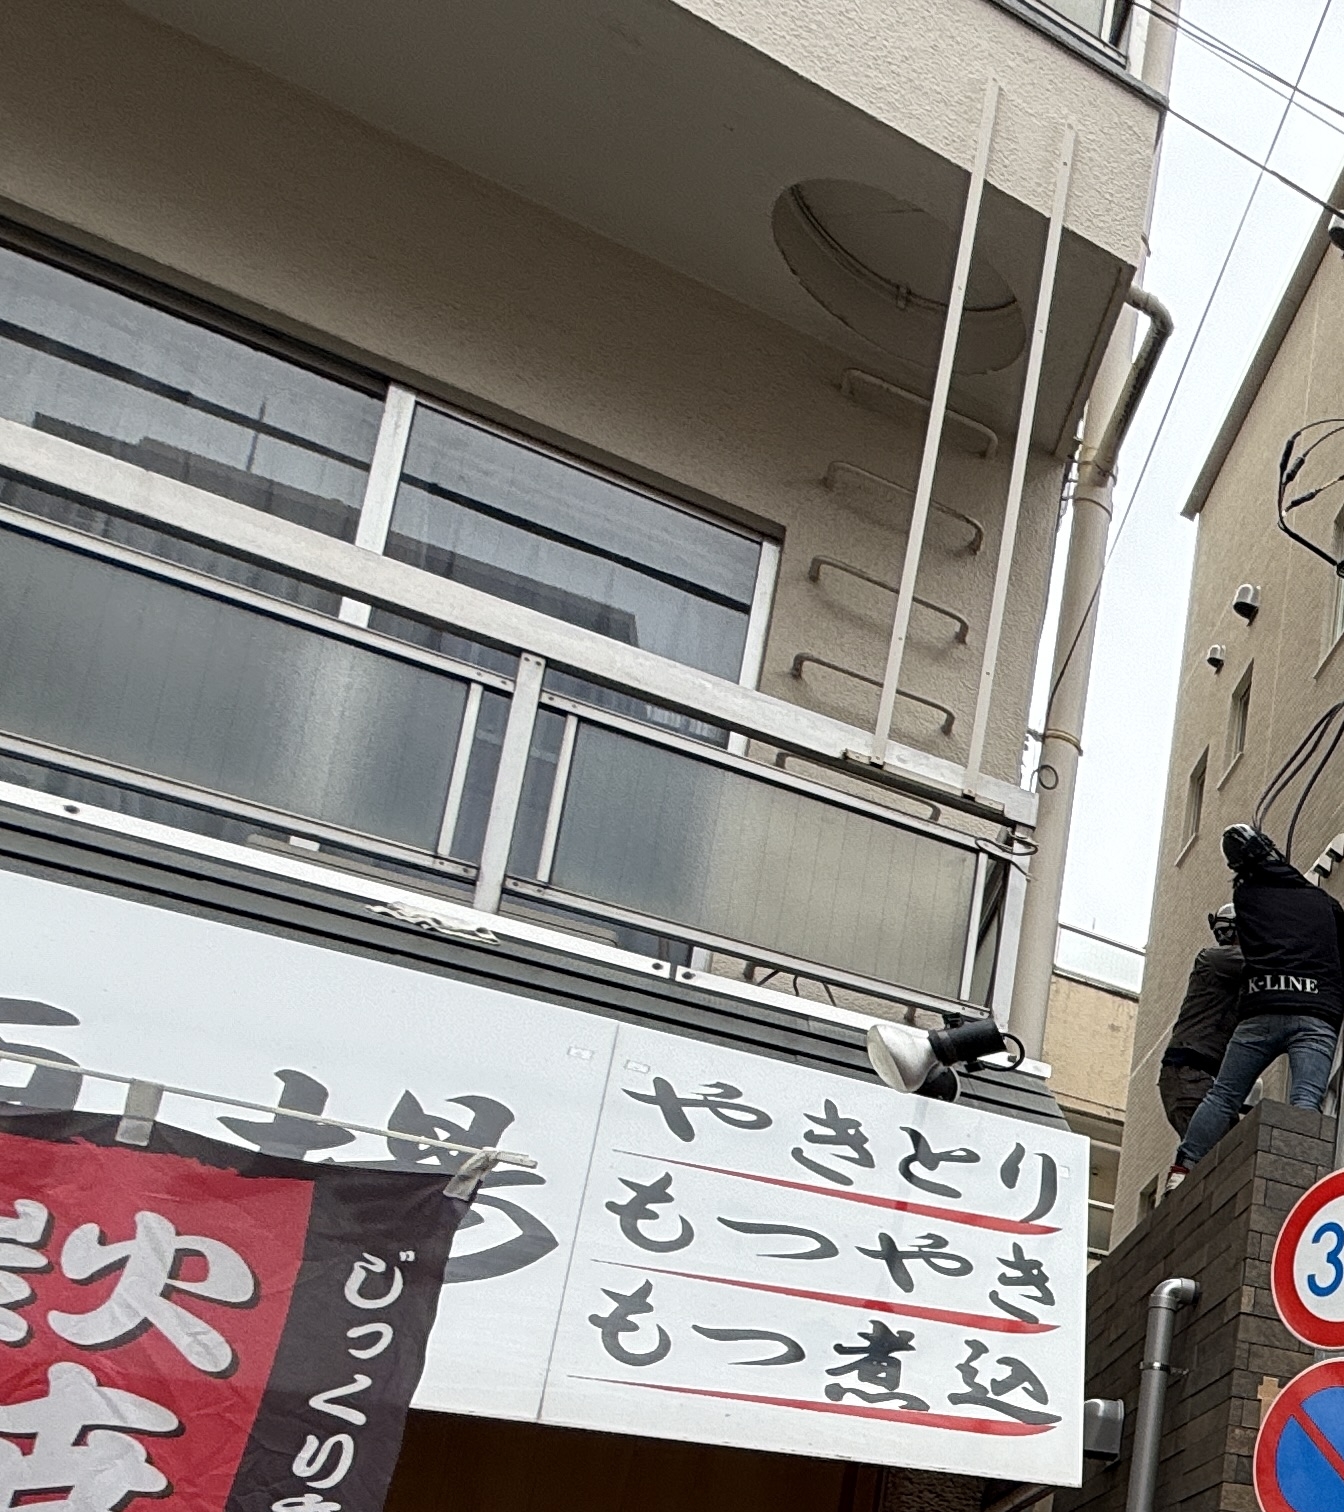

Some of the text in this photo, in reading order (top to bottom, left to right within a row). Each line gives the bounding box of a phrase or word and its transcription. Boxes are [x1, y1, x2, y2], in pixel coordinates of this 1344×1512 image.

[1248, 973, 1319, 996] K-LINE
[622, 1075, 1060, 1222] やきとり
[604, 1171, 1058, 1324] もつやき
[586, 1277, 1062, 1425] もつ煮込
